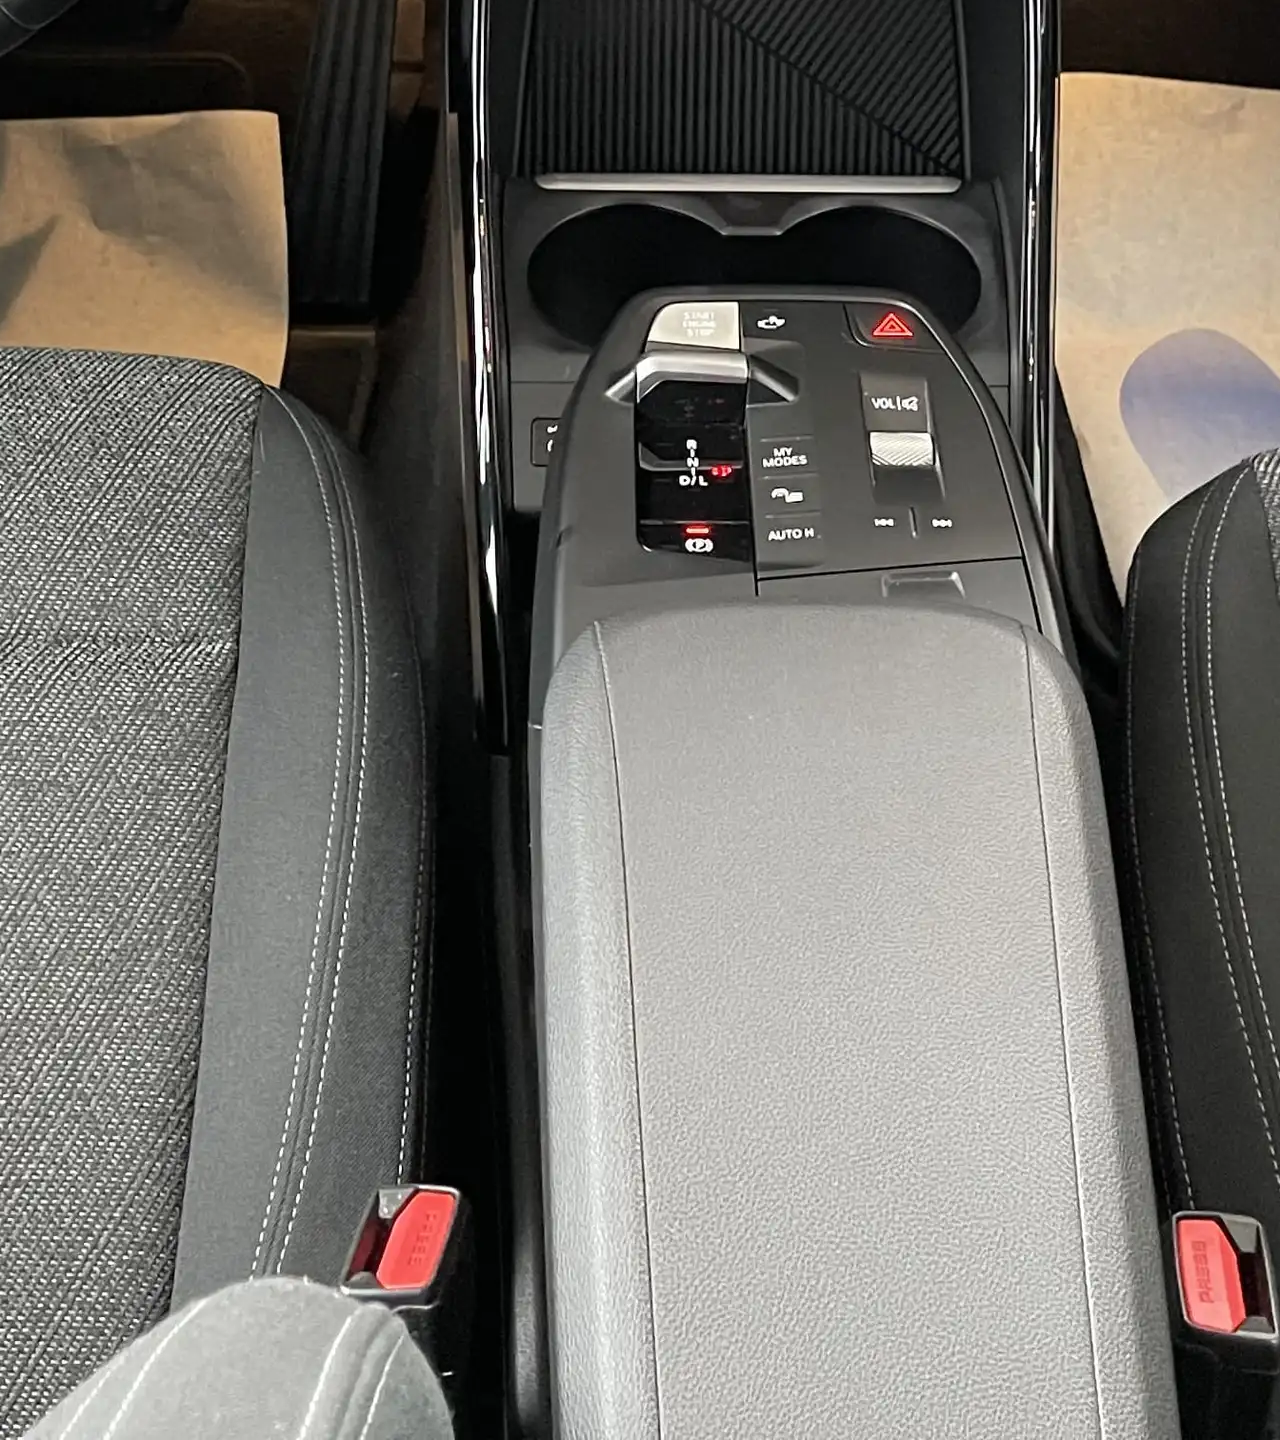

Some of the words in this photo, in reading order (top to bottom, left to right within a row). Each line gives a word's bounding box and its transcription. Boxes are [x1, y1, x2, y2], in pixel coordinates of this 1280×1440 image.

[871, 397, 896, 410] VOL
[773, 447, 793, 457] MY
[686, 457, 699, 468] N
[762, 455, 808, 468] MODES
[768, 528, 803, 541] AUTO
[804, 527, 815, 538] H
